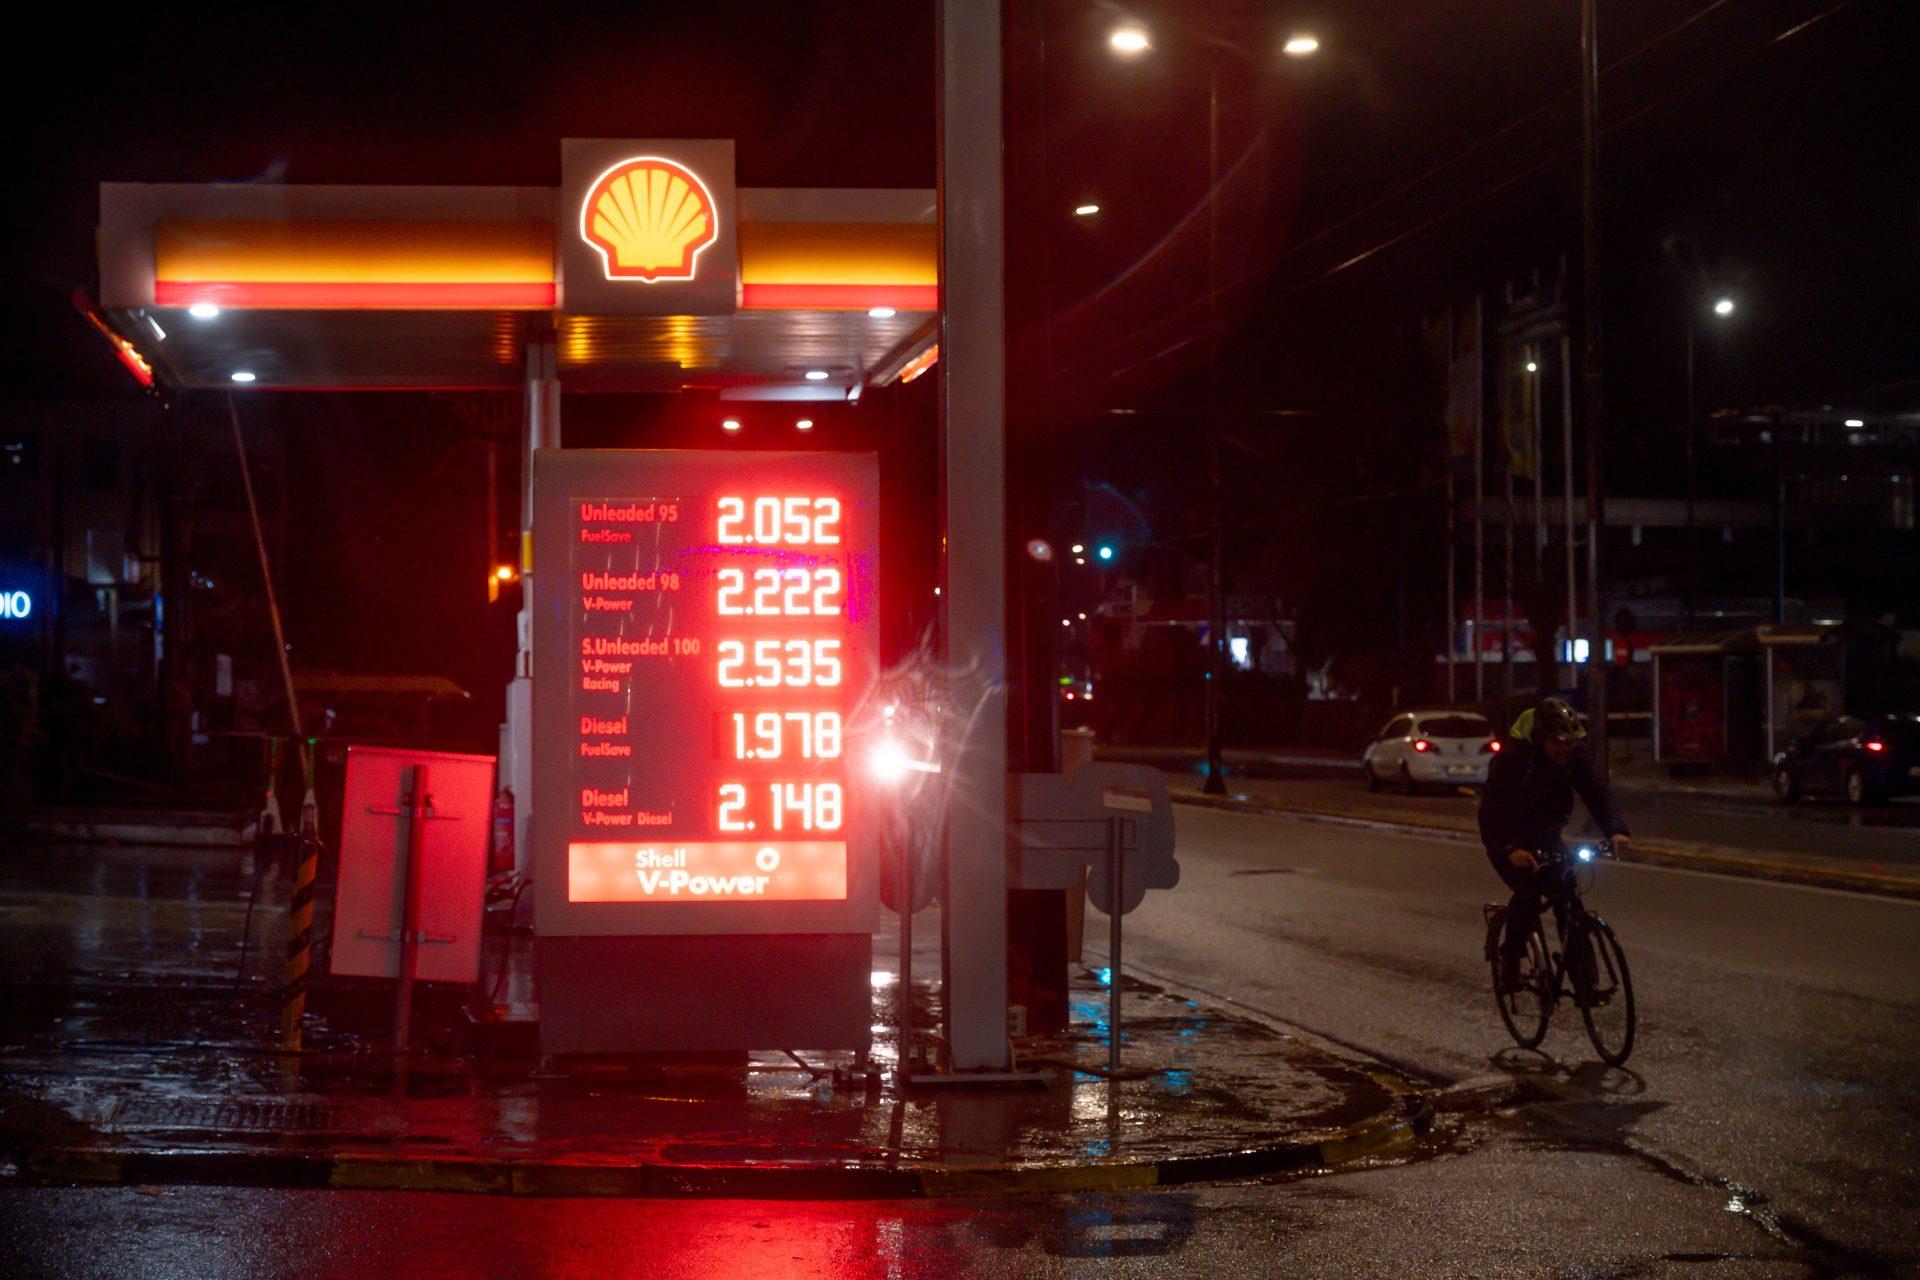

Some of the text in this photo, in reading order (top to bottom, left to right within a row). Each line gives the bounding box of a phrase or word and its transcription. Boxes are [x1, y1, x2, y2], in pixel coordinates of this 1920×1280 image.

[581, 504, 678, 522] Unleaded 95
[717, 497, 840, 543] 2.052
[581, 529, 632, 543] FuelSave
[582, 573, 679, 591] Unleaded 98
[717, 568, 840, 615] 2.222
[0, 590, 32, 618] IO
[583, 598, 633, 612] V-Power
[582, 638, 700, 655] S.Unleaded 100
[582, 660, 632, 674] V-Power
[717, 640, 841, 687] 2.535
[583, 677, 620, 693] Racing
[581, 716, 627, 734] Diesel
[733, 712, 841, 759] 1.978
[581, 743, 632, 757] FuelSave
[582, 789, 628, 807] Diesel
[583, 811, 672, 826] V-Power Diesel
[636, 848, 686, 868] Shell
[636, 870, 769, 895] V-Power
